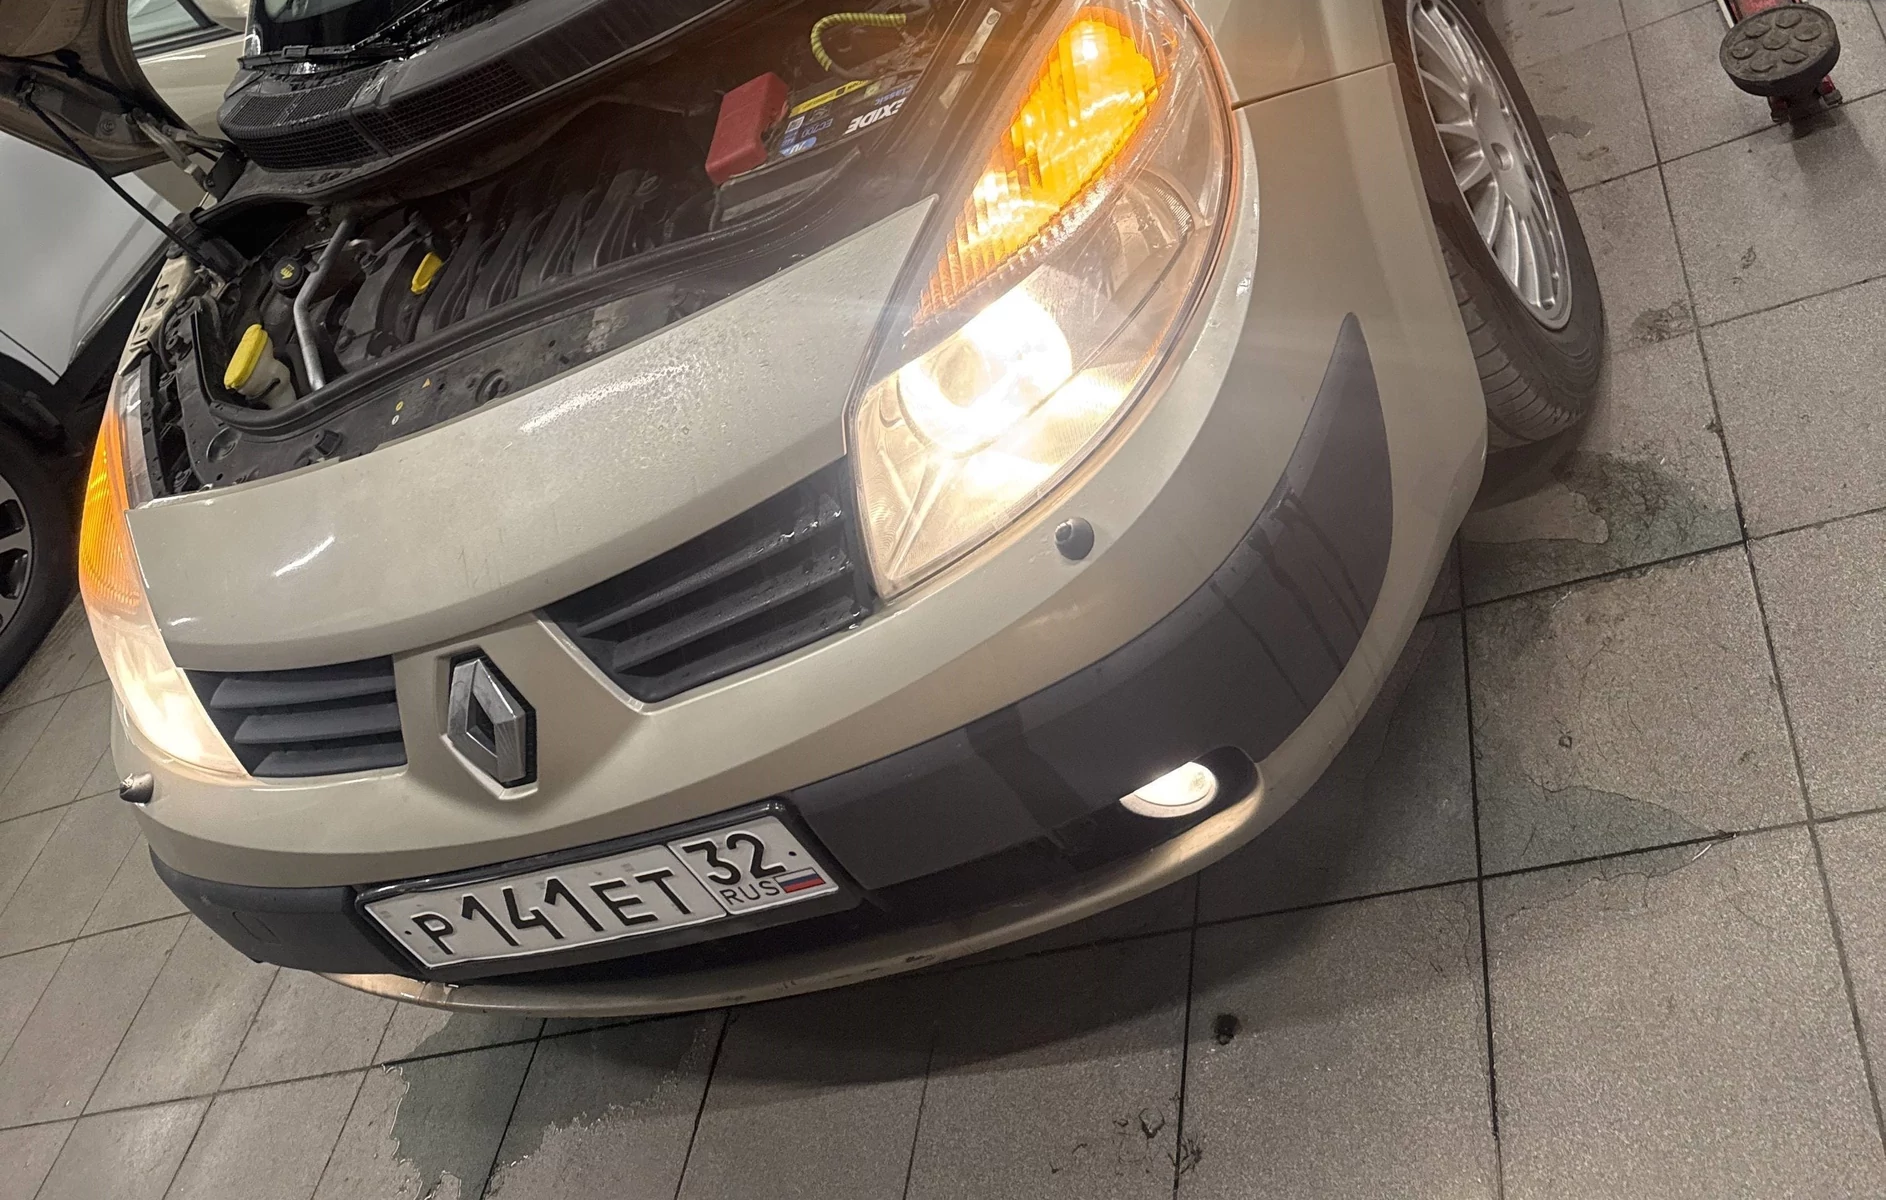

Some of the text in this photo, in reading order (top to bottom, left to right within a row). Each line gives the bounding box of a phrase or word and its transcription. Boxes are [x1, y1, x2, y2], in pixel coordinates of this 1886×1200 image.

[874, 83, 914, 105] Classic
[843, 97, 907, 136] EXIDE
[682, 833, 786, 885] 32
[719, 879, 781, 906] RUS
